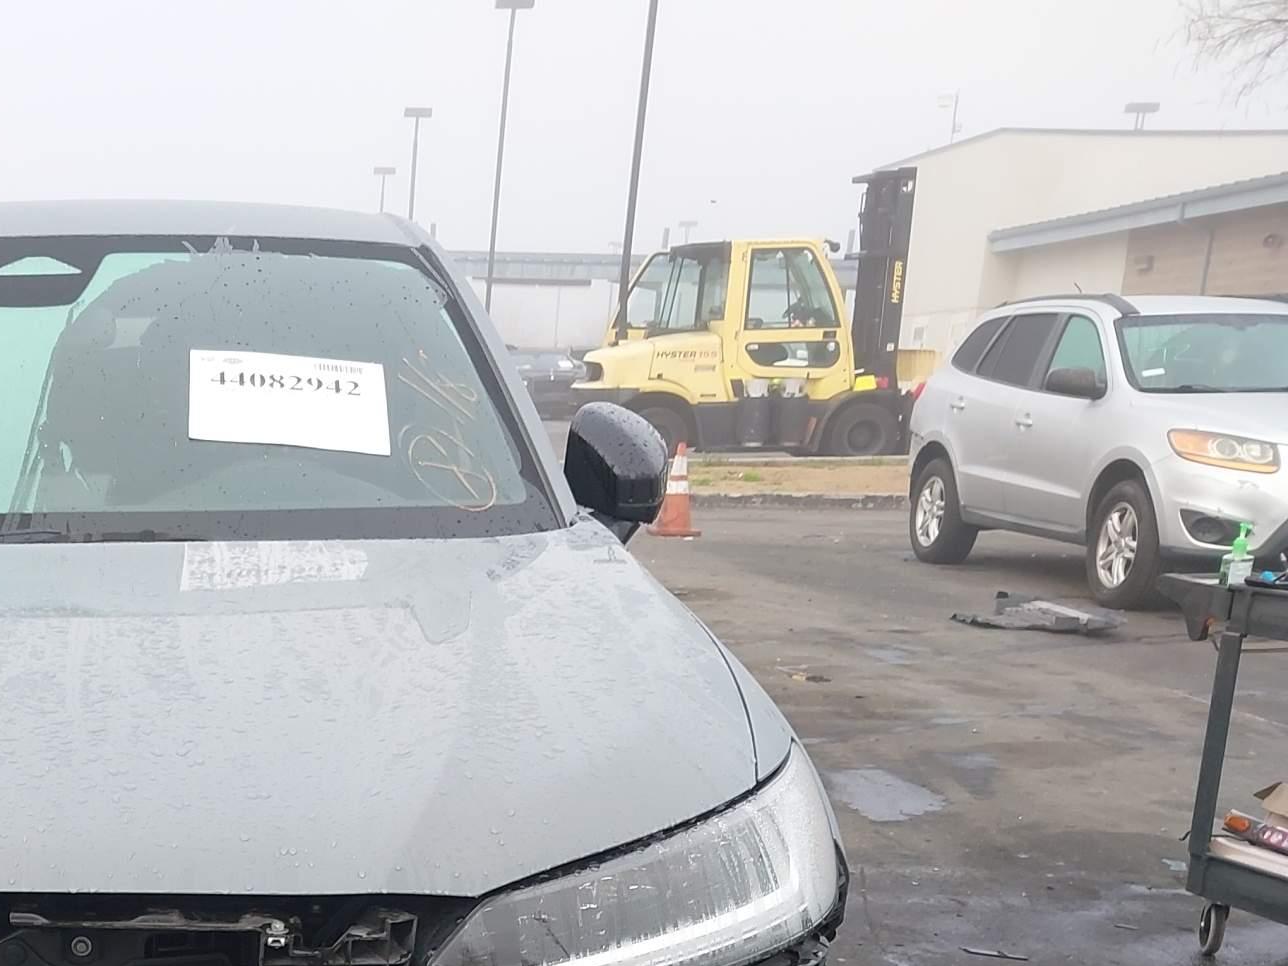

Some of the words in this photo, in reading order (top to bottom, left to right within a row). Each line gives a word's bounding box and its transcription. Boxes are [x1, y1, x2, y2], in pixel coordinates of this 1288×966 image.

[891, 261, 903, 303] HYSTER
[656, 351, 697, 359] HYSTER
[210, 371, 362, 396] 44082942
